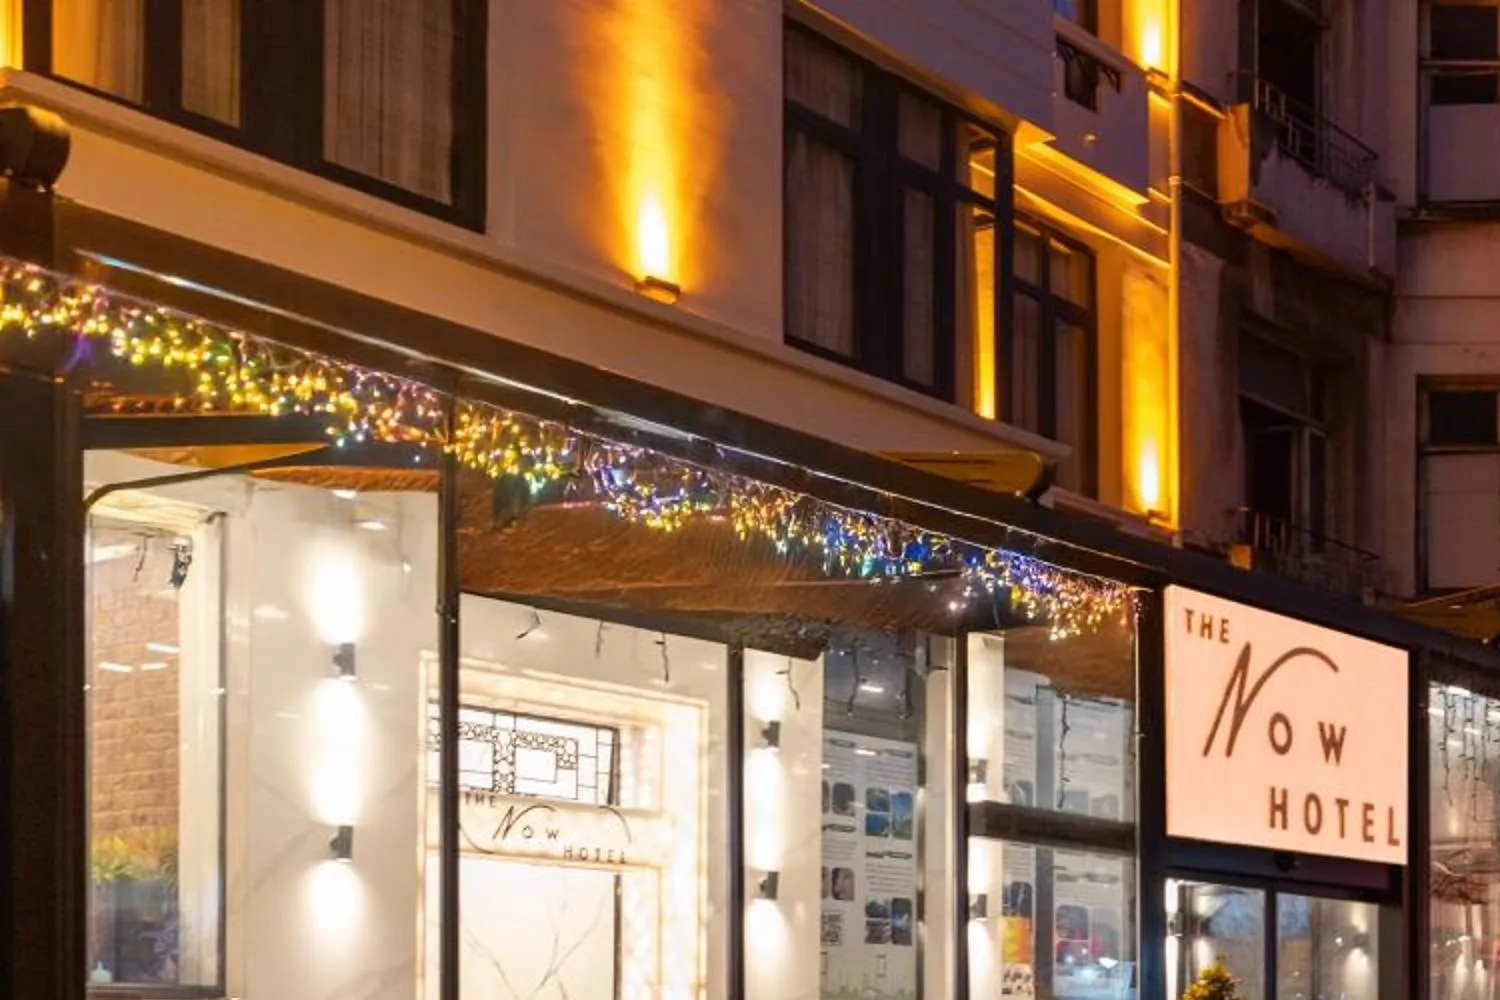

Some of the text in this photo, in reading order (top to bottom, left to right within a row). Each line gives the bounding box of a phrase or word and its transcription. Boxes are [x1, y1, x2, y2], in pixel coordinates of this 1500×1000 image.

[1184, 608, 1230, 643] THE
[1202, 642, 1347, 765] NOW
[492, 804, 560, 840] NOW
[1269, 786, 1400, 846] HOTEL
[564, 845, 628, 864] HOTEL
